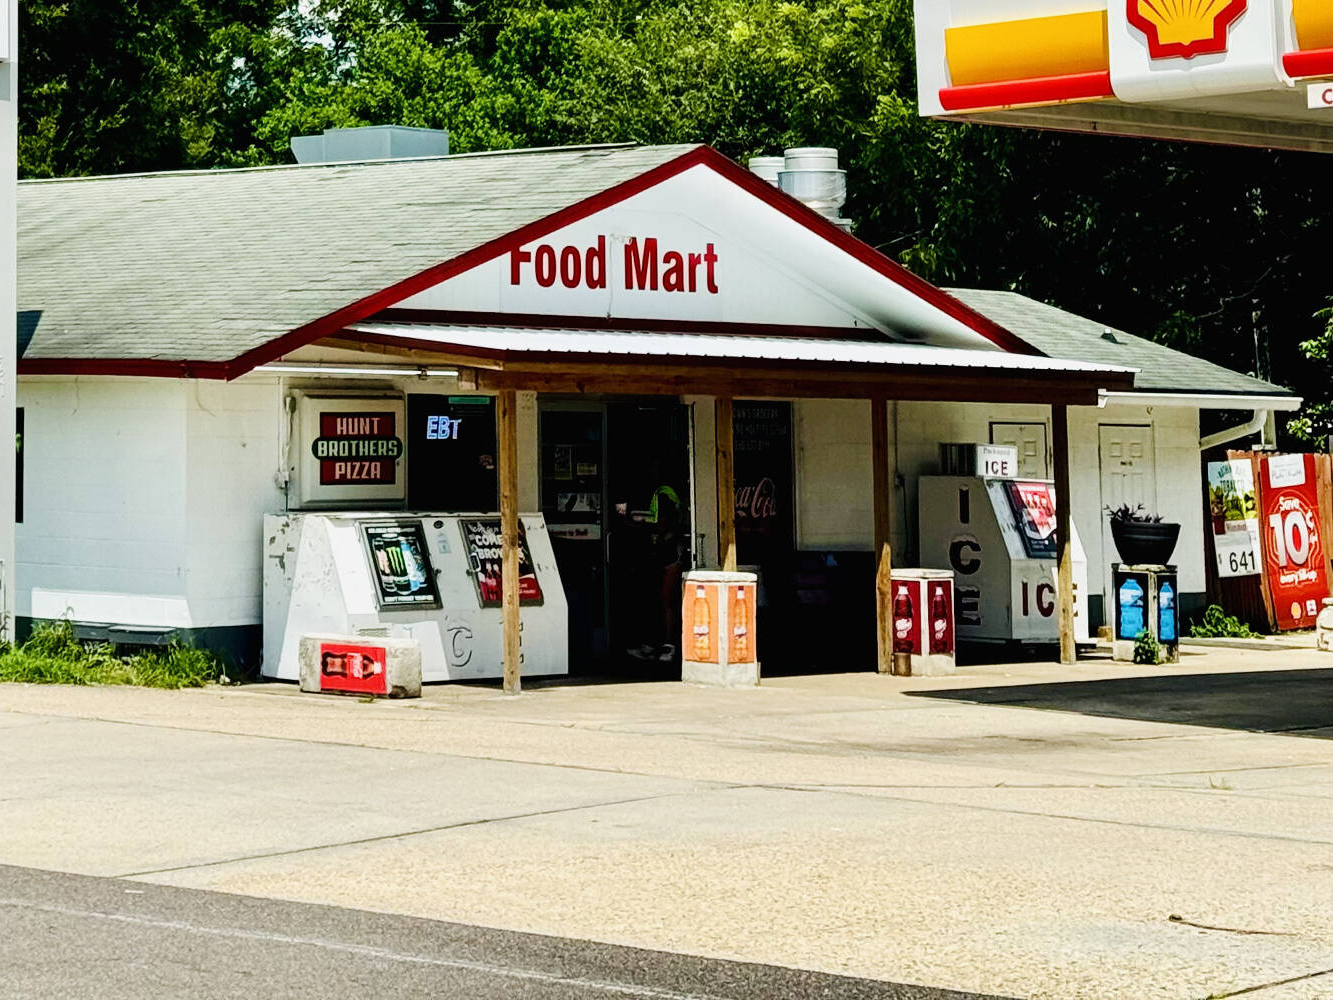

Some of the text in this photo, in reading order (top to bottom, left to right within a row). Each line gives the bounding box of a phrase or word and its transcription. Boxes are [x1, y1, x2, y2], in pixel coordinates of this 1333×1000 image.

[511, 235, 719, 294] Food Mart
[336, 417, 381, 436] HUNT
[426, 415, 463, 440] EBT
[317, 440, 398, 457] BROTHERS
[334, 461, 381, 480] PIZZA
[985, 460, 1009, 476] ICE
[1279, 496, 1300, 511] Save
